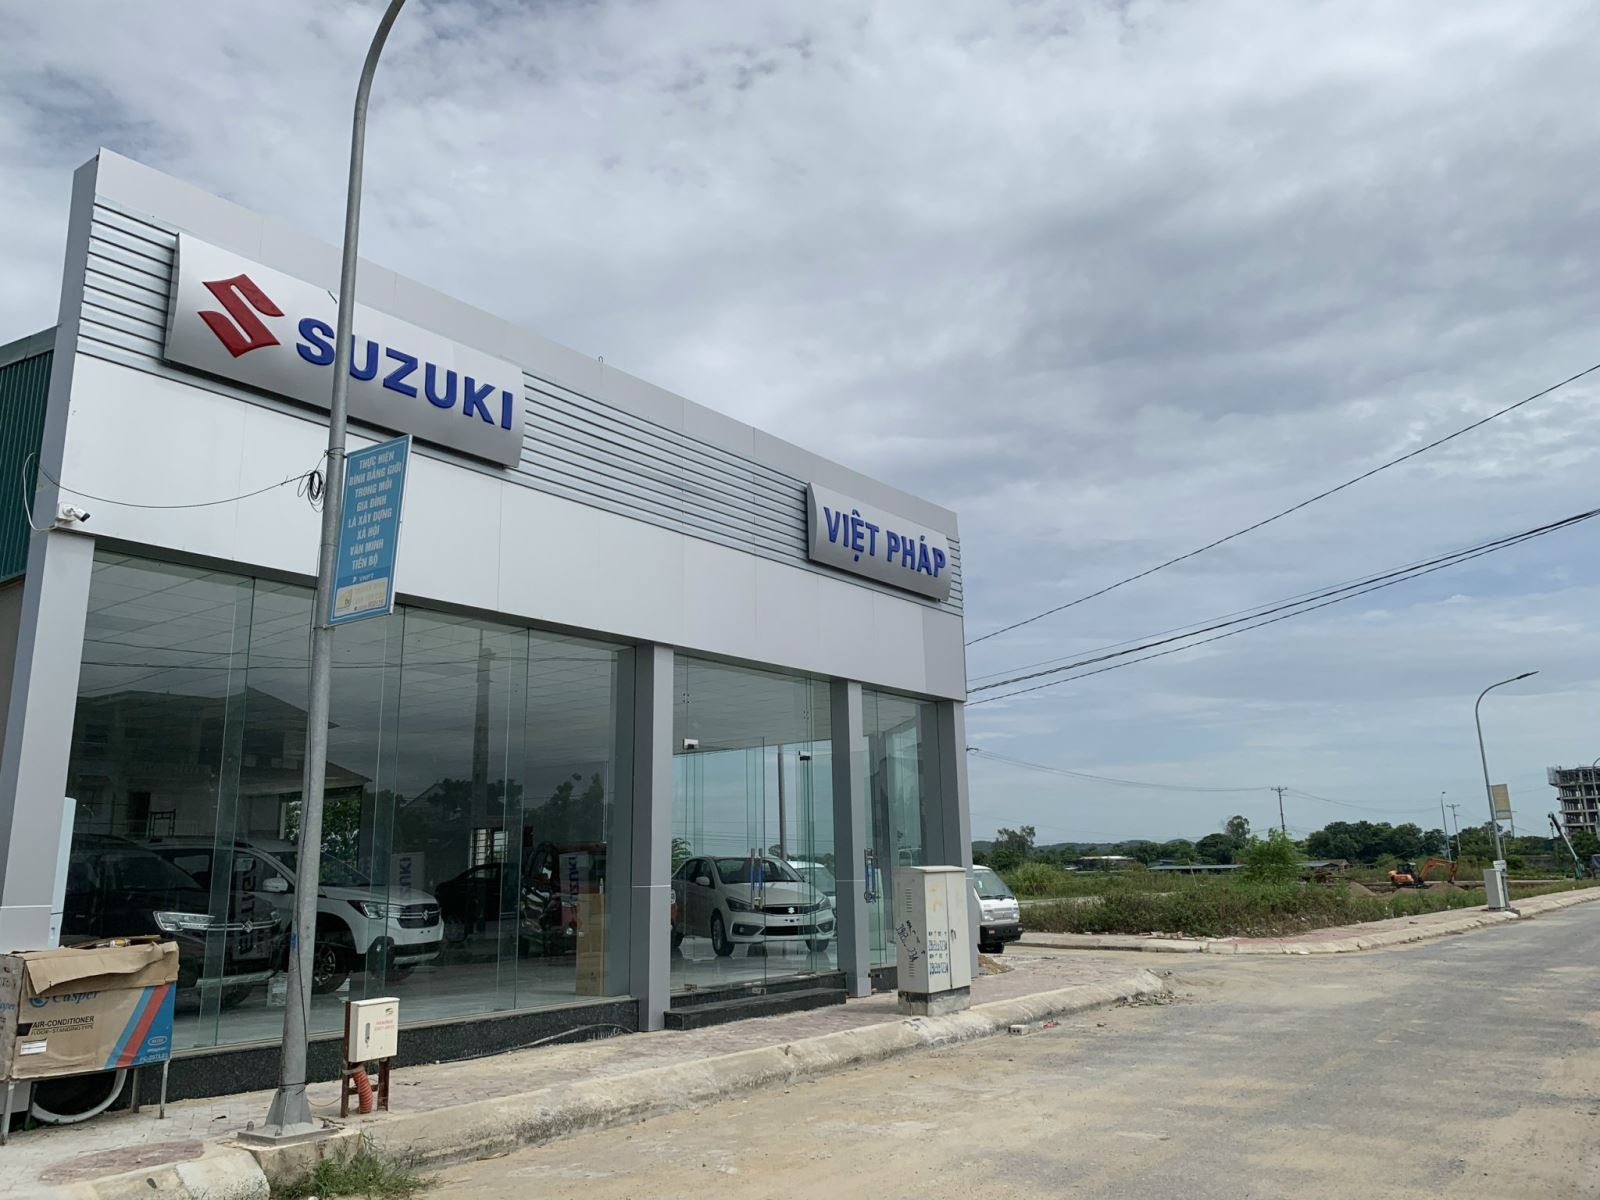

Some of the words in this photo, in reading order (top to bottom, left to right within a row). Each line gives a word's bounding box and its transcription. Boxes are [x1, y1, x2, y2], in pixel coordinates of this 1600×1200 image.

[296, 317, 513, 431] SUZUKI
[359, 456, 377, 470] THỰC
[377, 450, 395, 464] HIỆN
[354, 484, 378, 498] TRONG
[356, 499, 368, 512] GIA
[357, 511, 372, 525] XÂY
[368, 523, 380, 538] HỘI
[365, 538, 384, 553] MINH
[823, 506, 880, 562] VIỆT
[886, 530, 946, 578] PHÁP
[352, 556, 368, 570] TIẾN
[368, 552, 379, 567] BỘ
[32, 1016, 95, 1028] AIR-CONDITIONER
